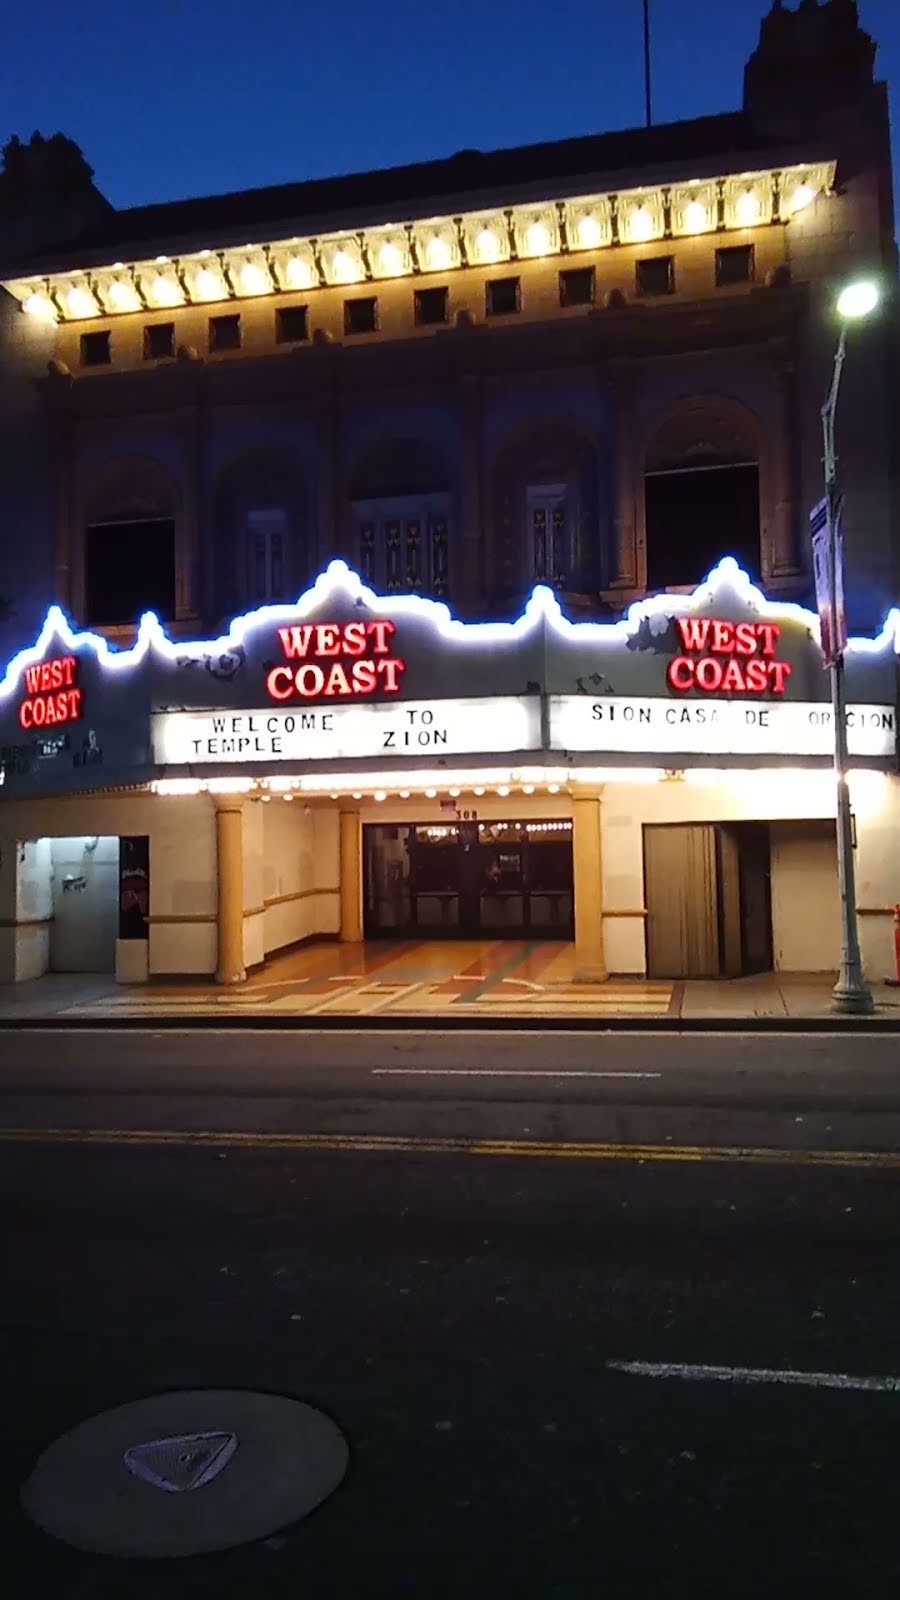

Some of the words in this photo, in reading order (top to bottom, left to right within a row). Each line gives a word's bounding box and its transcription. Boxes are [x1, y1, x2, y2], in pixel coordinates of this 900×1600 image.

[278, 621, 395, 659] WEST
[676, 617, 781, 655] WEST
[25, 657, 77, 694] WEST
[266, 658, 405, 701] COAST
[667, 656, 792, 694] COAST
[20, 690, 81, 729] COAST
[212, 713, 334, 734] WELCOME
[406, 709, 434, 726] TO
[592, 704, 651, 723] SION
[665, 707, 720, 725] CASA
[745, 710, 770, 727] DE
[808, 711, 894, 731] ORCION
[191, 736, 283, 755] TEMPLE
[382, 729, 448, 749] ZION
